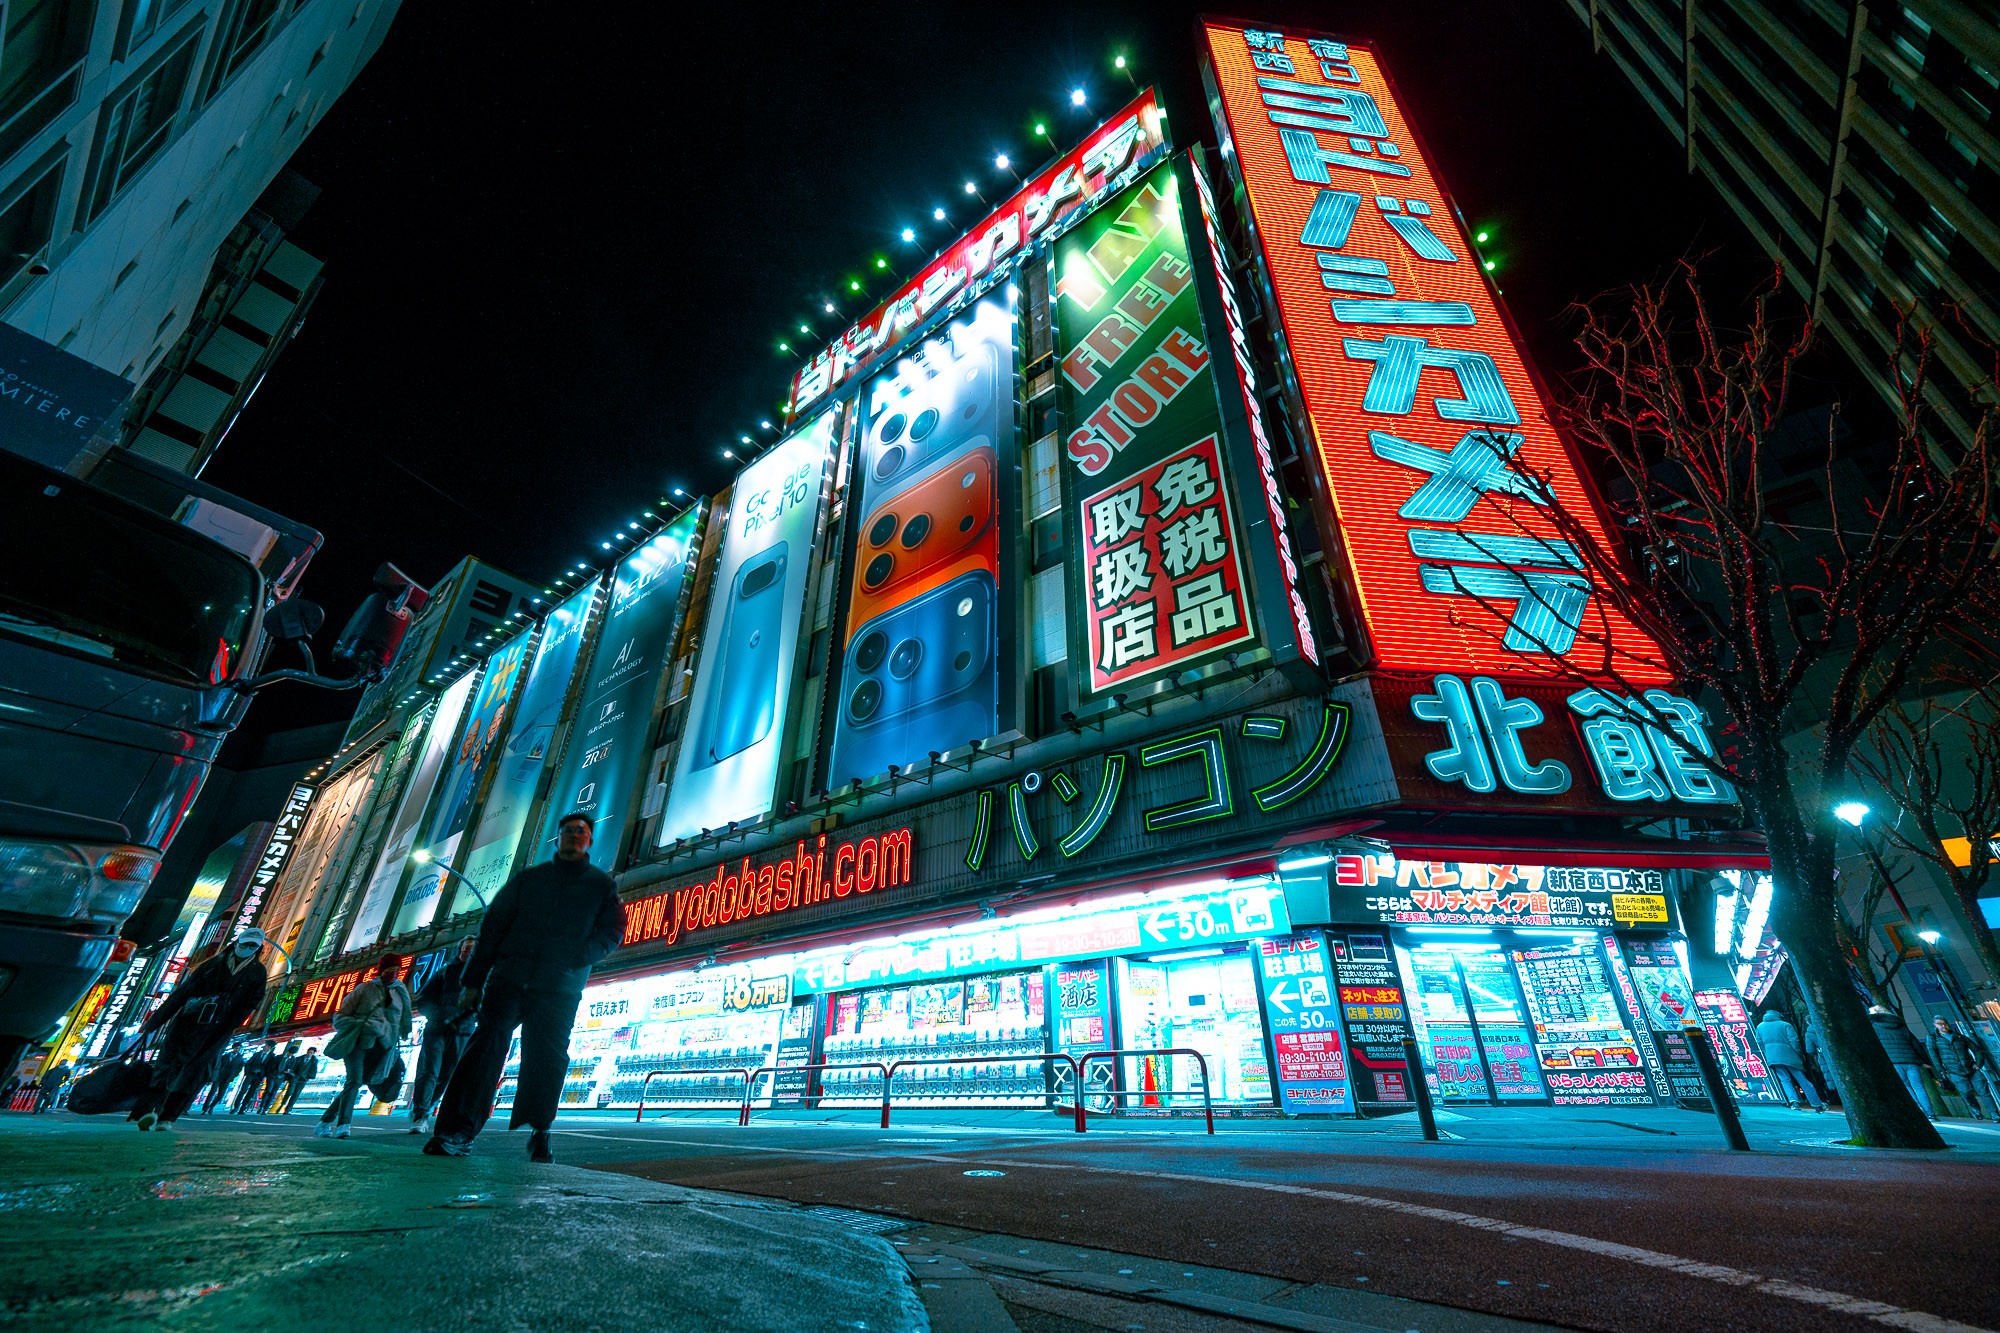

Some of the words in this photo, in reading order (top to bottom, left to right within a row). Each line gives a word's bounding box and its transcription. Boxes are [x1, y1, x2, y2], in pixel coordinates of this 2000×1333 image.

[795, 113, 1139, 413] ヨドバシカメラ
[1061, 250, 1193, 396] FREE
[1256, 76, 1590, 655] ヨドバシカメラ
[1066, 325, 1210, 477] STORE
[746, 463, 811, 514] Gogle
[788, 482, 808, 509] 10
[1153, 455, 1238, 647] 免税品
[1091, 485, 1156, 670] 取扱店
[597, 656, 644, 688] TECHNOLOGY
[612, 638, 635, 669] AI
[1410, 674, 1740, 803] 北館
[965, 702, 1349, 872] パソコン
[254, 785, 313, 886] ヨドバシカメラ
[624, 827, 911, 946] ww.yodobashi.com
[1336, 854, 1545, 891] ヨドバシカメラ
[1548, 867, 1664, 893] 新宿西口本店
[1261, 935, 1320, 956] ヨドバシ
[1263, 952, 1324, 978] 駐車場
[103, 957, 149, 1025] ヨドバシカメラ
[1057, 970, 1099, 984] ヨドバシ
[1060, 983, 1098, 1009] 酒店
[1342, 988, 1400, 1003] ネットで注文
[1274, 1017, 1298, 1027] この先
[1299, 1010, 1335, 1029] 50m
[1347, 1006, 1402, 1020] 店舗で受取り
[1603, 937, 1639, 1018] ヨドバシカメラ
[1633, 1018, 1669, 1097] 新宿西口本店
[1732, 1022, 1767, 1078] ゲーム機
[1436, 1062, 1484, 1082] 新しい
[1547, 1073, 1646, 1088] いらっしゃいませ
[1287, 1087, 1345, 1099] ヨドバシカメラ
[1554, 1096, 1610, 1105] ヨドバシカメラ
